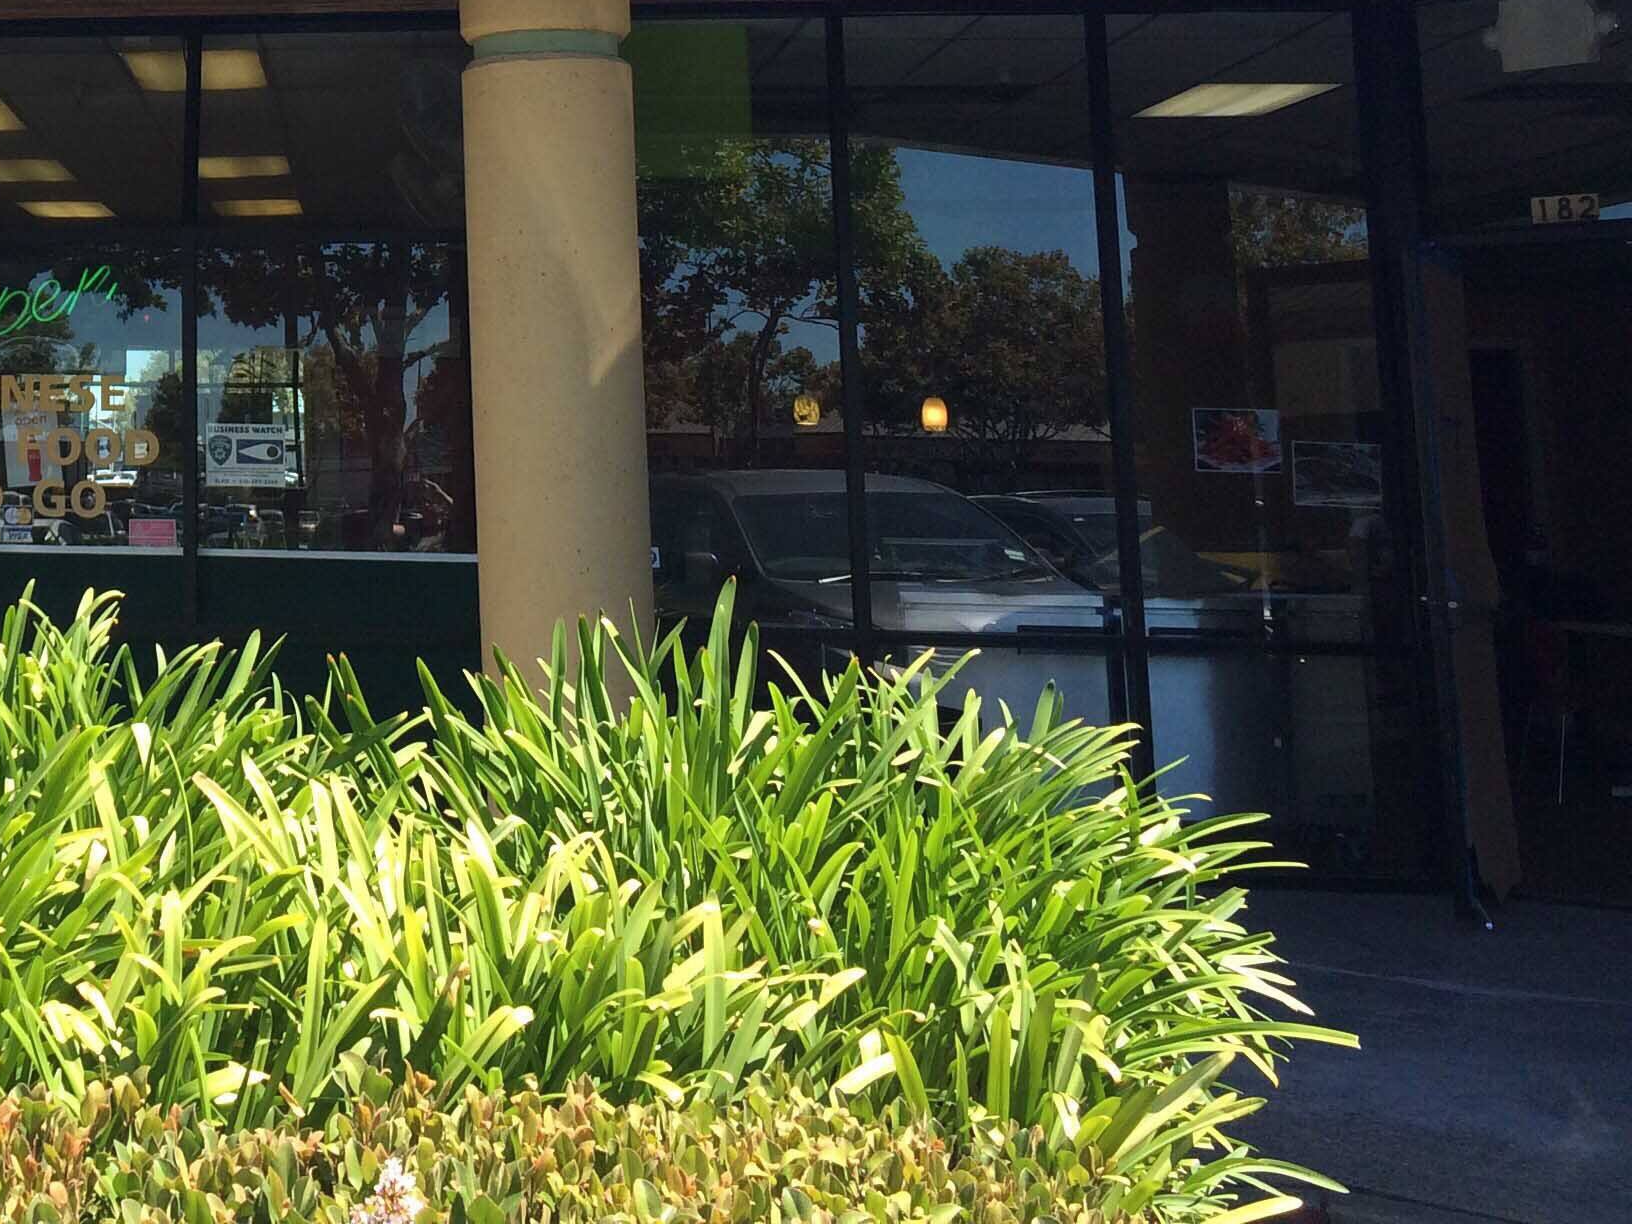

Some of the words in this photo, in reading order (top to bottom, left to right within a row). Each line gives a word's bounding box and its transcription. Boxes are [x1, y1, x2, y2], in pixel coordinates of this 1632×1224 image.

[1537, 196, 1598, 221] 182
[21, 427, 160, 466] FOOD
[32, 478, 107, 518] GO
